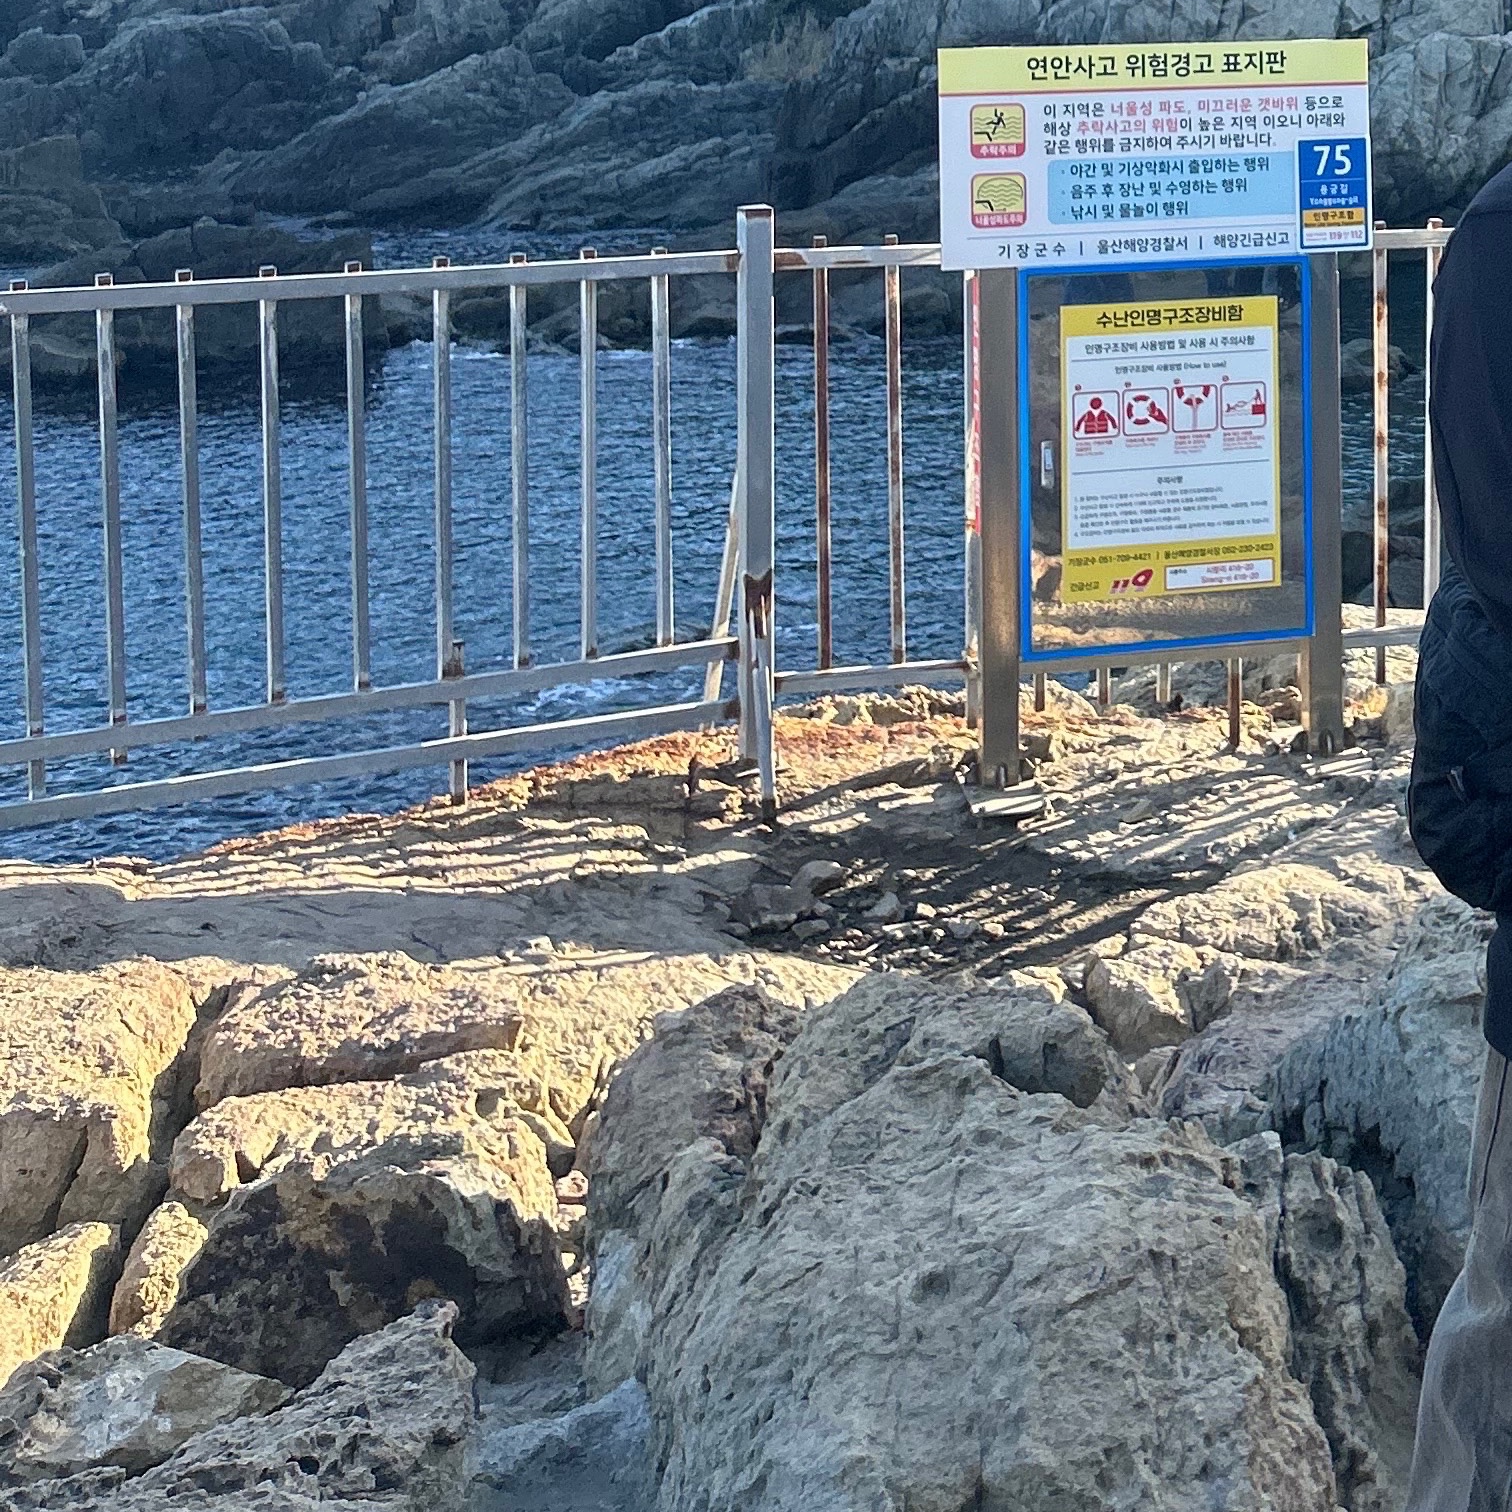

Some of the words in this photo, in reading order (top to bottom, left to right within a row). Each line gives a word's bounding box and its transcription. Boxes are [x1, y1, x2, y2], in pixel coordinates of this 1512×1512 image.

[1026, 54, 1118, 79] 연안사고
[1126, 53, 1215, 77] 위험경고
[1222, 51, 1286, 74] 표지판
[1043, 104, 1057, 117] 이
[1062, 103, 1105, 117] 지역은
[1110, 100, 1153, 115] 너울성
[1197, 98, 1253, 112] 미끄러운
[1258, 97, 1299, 111] 갯바위
[1304, 96, 1344, 110] 등으로
[1043, 121, 1071, 136] 해상
[1077, 118, 1146, 134] 추락사고의
[1152, 117, 1192, 133] 위험이
[1198, 116, 1225, 132] 높은
[1231, 115, 1257, 129] 지역
[1263, 114, 1302, 129] 이오니
[1306, 113, 1345, 128] 아래와
[979, 143, 1017, 155] 추락주의
[1044, 138, 1071, 154] 같은
[1075, 137, 1114, 154] 행위를
[1118, 135, 1173, 152] 금지하여
[1177, 134, 1216, 150] 주시기
[1071, 163, 1098, 179] 야간
[1102, 163, 1114, 177] 및
[1119, 160, 1184, 177] 기상악화시
[1188, 158, 1240, 173] 출입하는
[1244, 157, 1270, 172] 행위
[1313, 144, 1352, 176] 75
[1071, 184, 1098, 199] 음주
[1102, 183, 1114, 198] 후
[1119, 181, 1145, 197] 장난
[1149, 181, 1162, 195] 및
[1166, 179, 1218, 195] 수영하는
[1222, 177, 1248, 192] 행위
[1071, 205, 1098, 220] 낚시
[1102, 205, 1115, 217] 및
[1119, 202, 1160, 217] 물놀이
[1163, 201, 1188, 216] 행위
[1097, 236, 1189, 255] 울산해양경찰서
[1213, 231, 1289, 249] 해양긴급신고
[1096, 305, 1244, 328] 수난인명구조장비함
[1220, 335, 1255, 347] 주의사항
